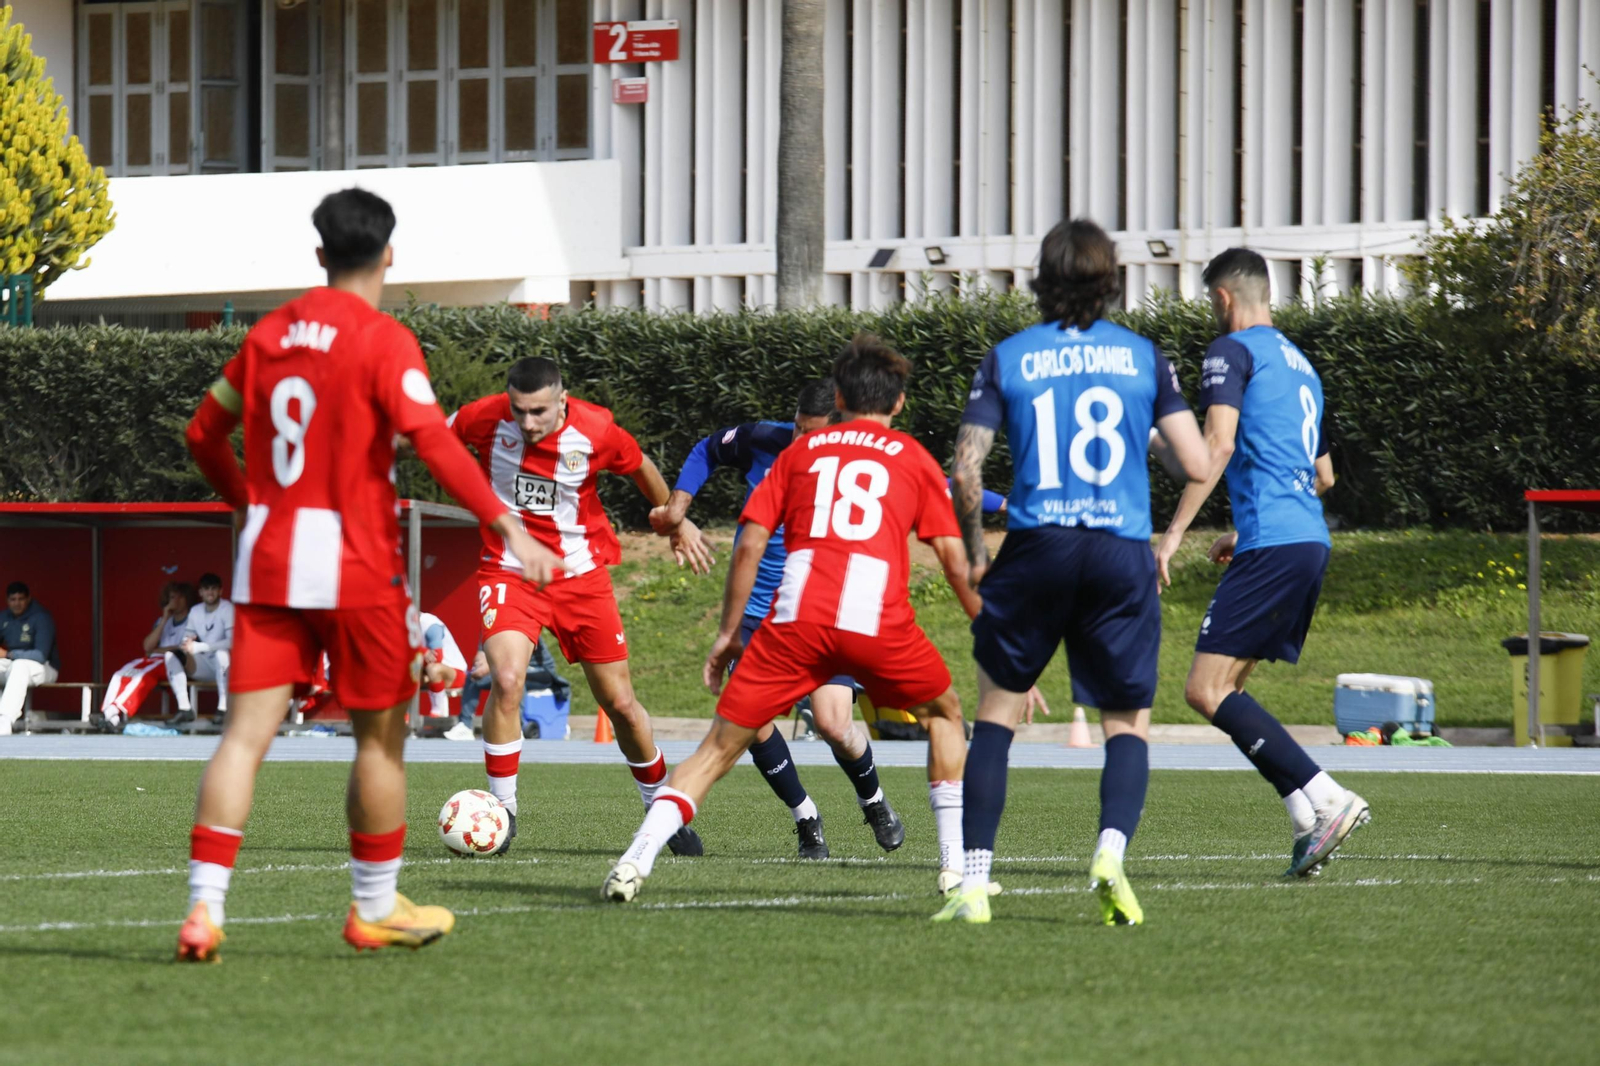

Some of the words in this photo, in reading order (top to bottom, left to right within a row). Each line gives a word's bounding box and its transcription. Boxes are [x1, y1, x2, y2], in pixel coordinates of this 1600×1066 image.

[608, 24, 627, 60] 2
[1021, 344, 1083, 382] CARLOS
[1083, 344, 1139, 376] DANIEL
[270, 375, 317, 488] 8
[808, 430, 904, 456] MORILLO
[1032, 385, 1126, 491] 18
[1299, 384, 1319, 465] 8
[524, 495, 546, 505] ZN
[525, 482, 546, 494] DA
[808, 456, 890, 541] 18
[479, 583, 507, 614] 21
